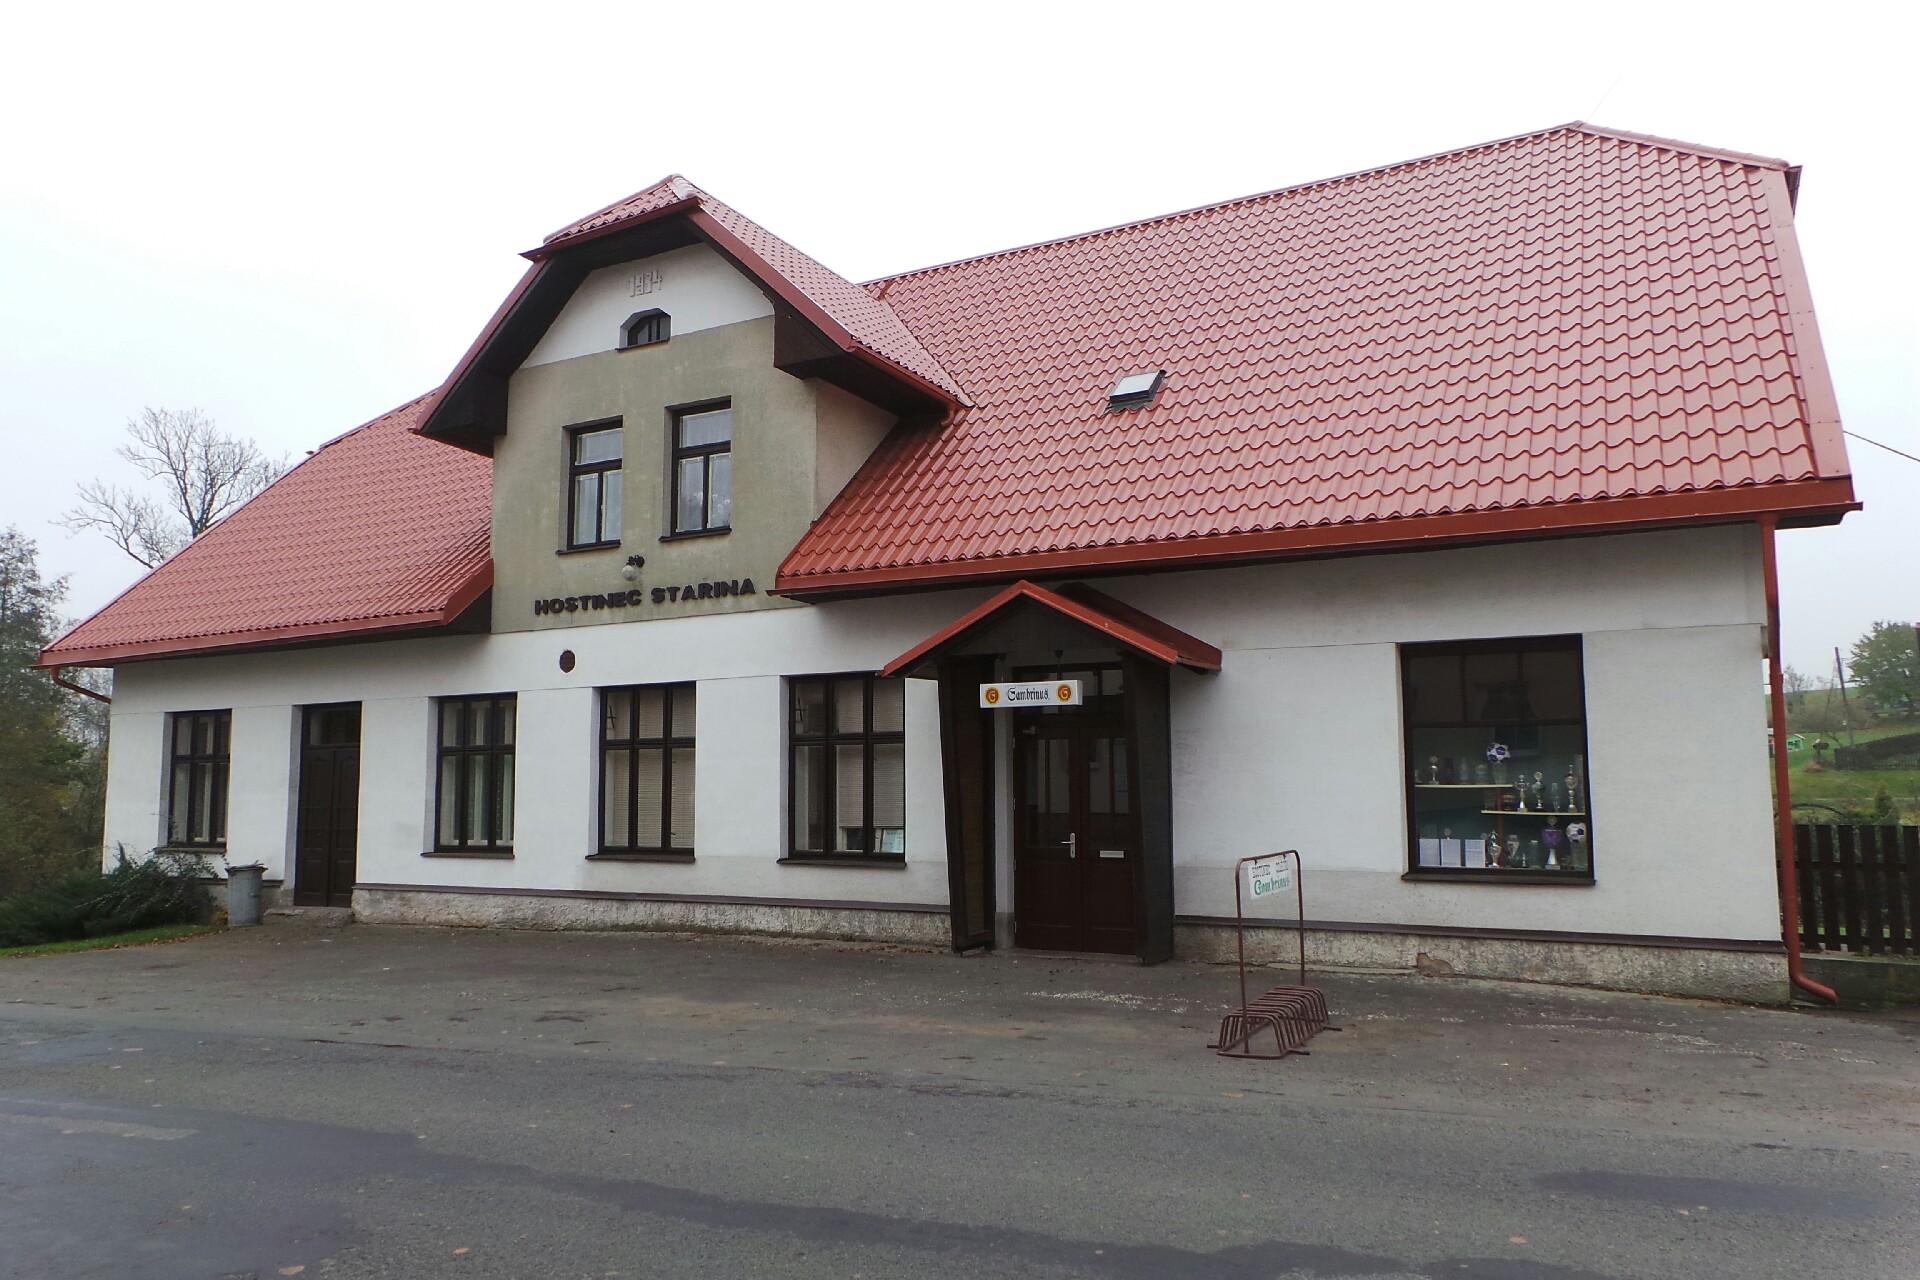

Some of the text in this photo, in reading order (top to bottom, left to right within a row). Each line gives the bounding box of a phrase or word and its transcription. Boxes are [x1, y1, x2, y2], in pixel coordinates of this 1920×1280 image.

[534, 578, 756, 615] HOSTINEC STARINA
[1008, 687, 1048, 702] Gambrinus
